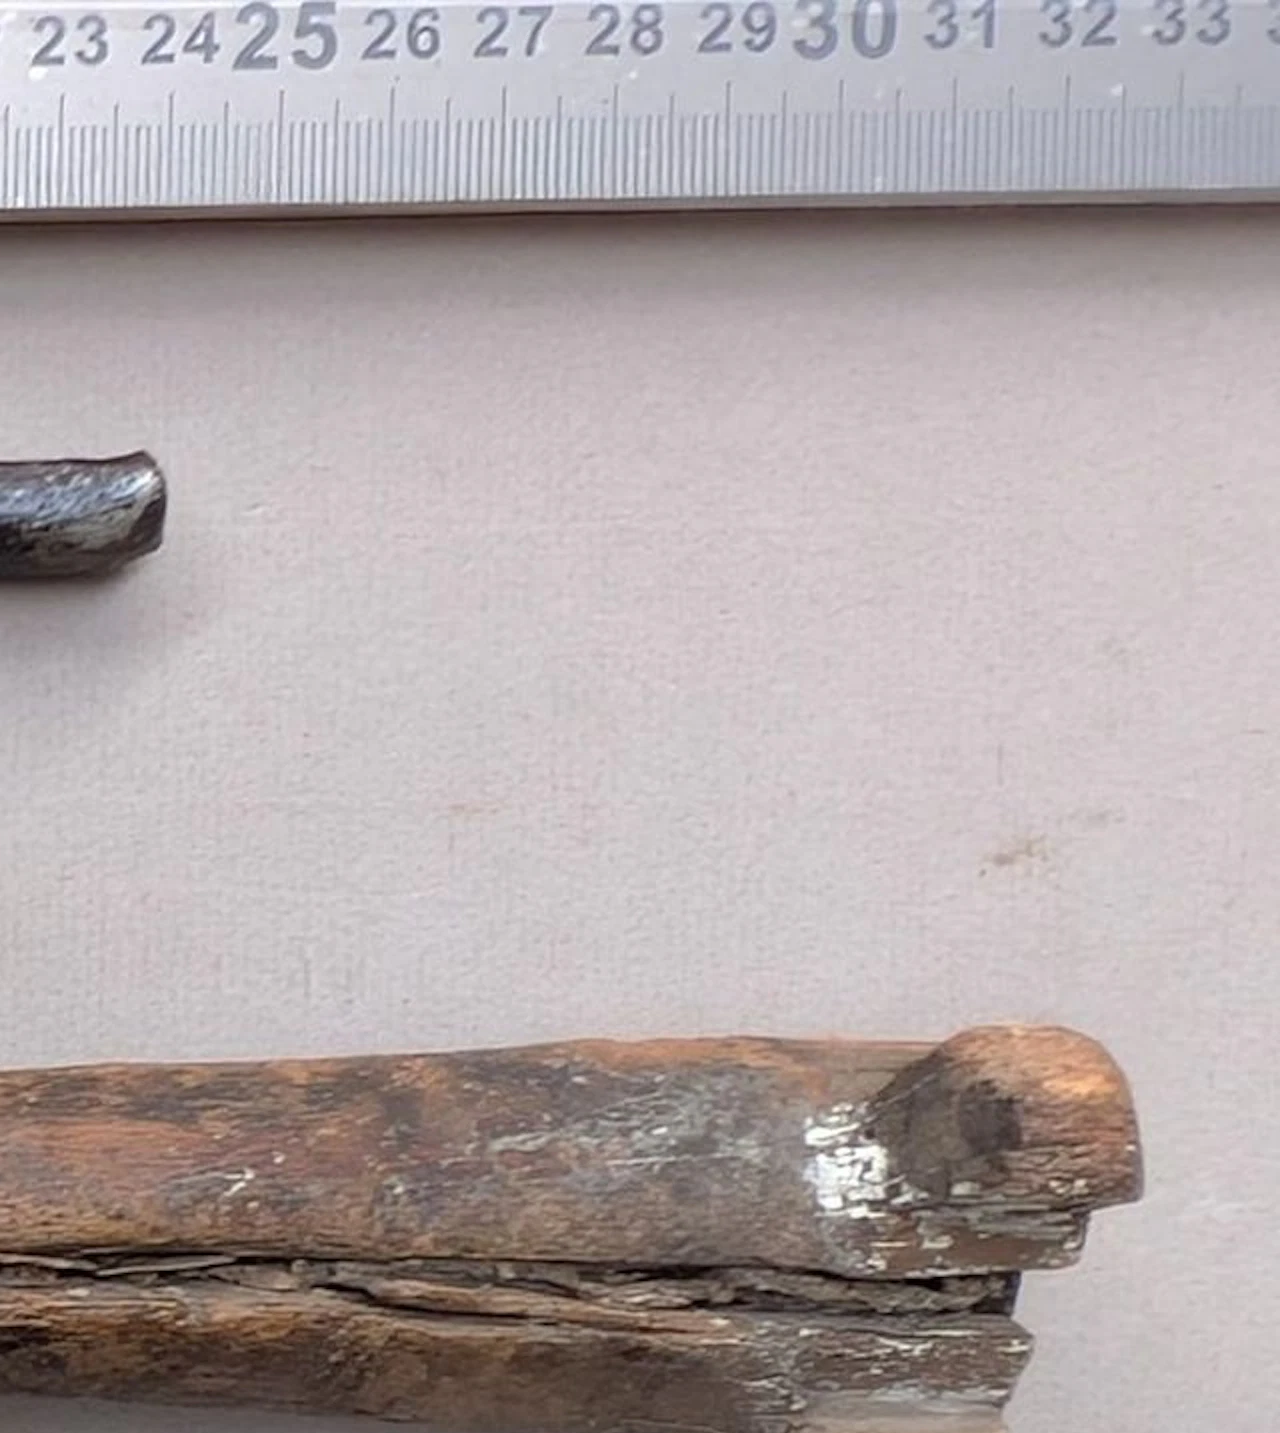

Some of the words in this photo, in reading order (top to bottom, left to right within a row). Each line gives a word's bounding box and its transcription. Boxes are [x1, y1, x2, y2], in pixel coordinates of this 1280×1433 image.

[32, 15, 108, 66] 23
[141, 12, 220, 64] 24
[233, 2, 337, 70] 25
[362, 8, 440, 60] 26
[474, 6, 550, 57] 27
[585, 4, 664, 55] 28
[697, 2, 776, 54] 29
[793, 0, 897, 60] 30
[924, 0, 994, 49] 31
[1040, 0, 1117, 48] 32
[1152, 0, 1230, 46] 33
